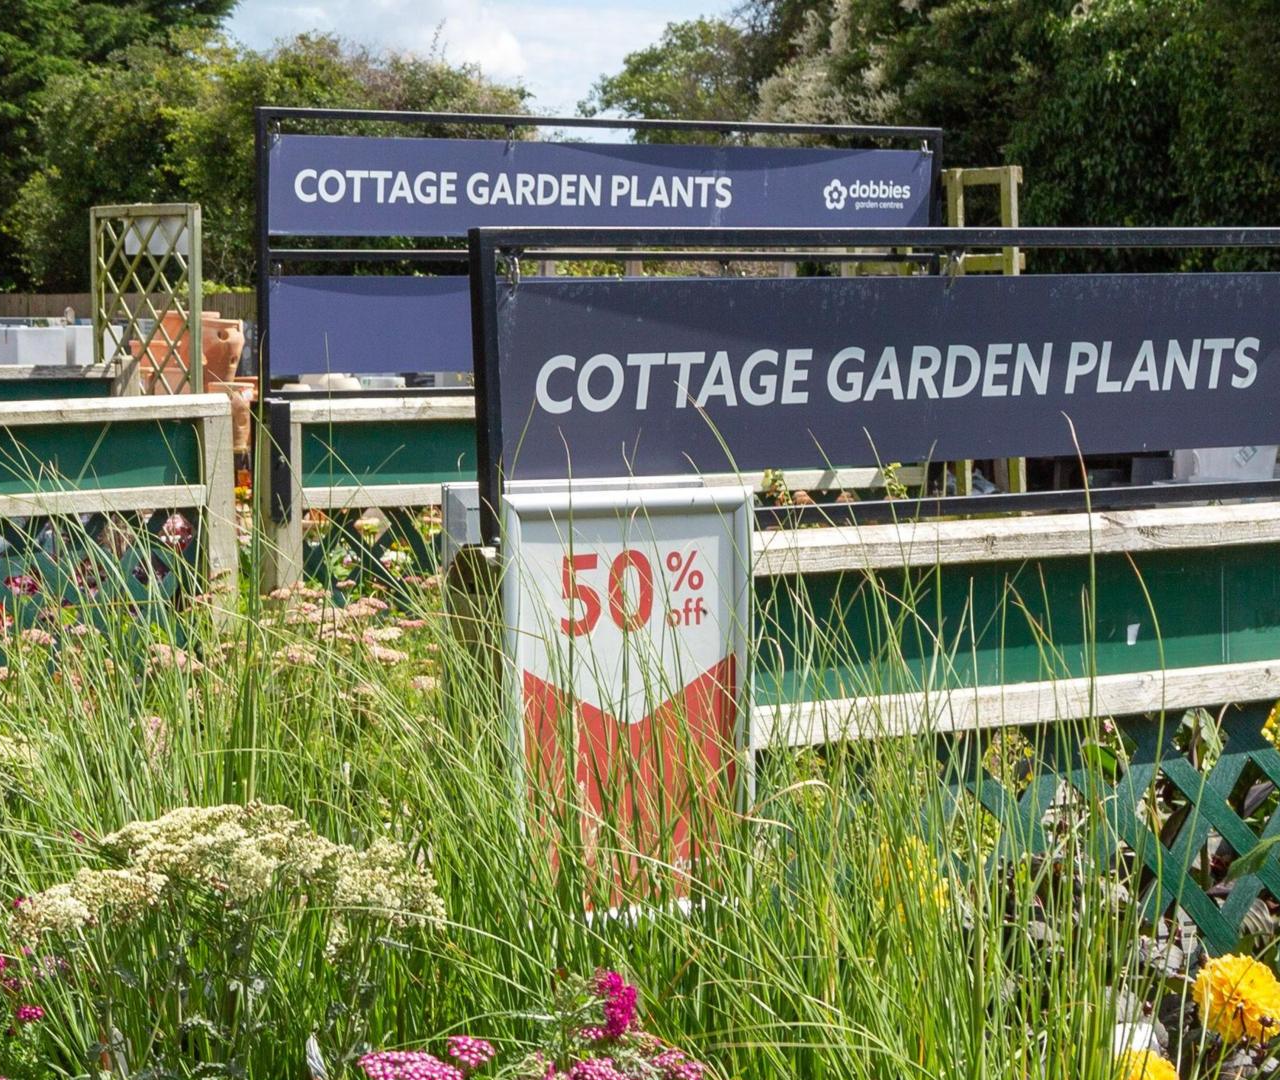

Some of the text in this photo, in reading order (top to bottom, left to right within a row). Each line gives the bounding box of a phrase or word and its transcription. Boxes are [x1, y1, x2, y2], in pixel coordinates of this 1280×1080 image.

[294, 168, 732, 210] COTTAGE GARDEN PLANTS
[849, 180, 911, 199] dobbies
[855, 200, 878, 211] garden
[534, 335, 1260, 414] COTTAGE GARDEN PLANTS
[666, 597, 704, 628] off
